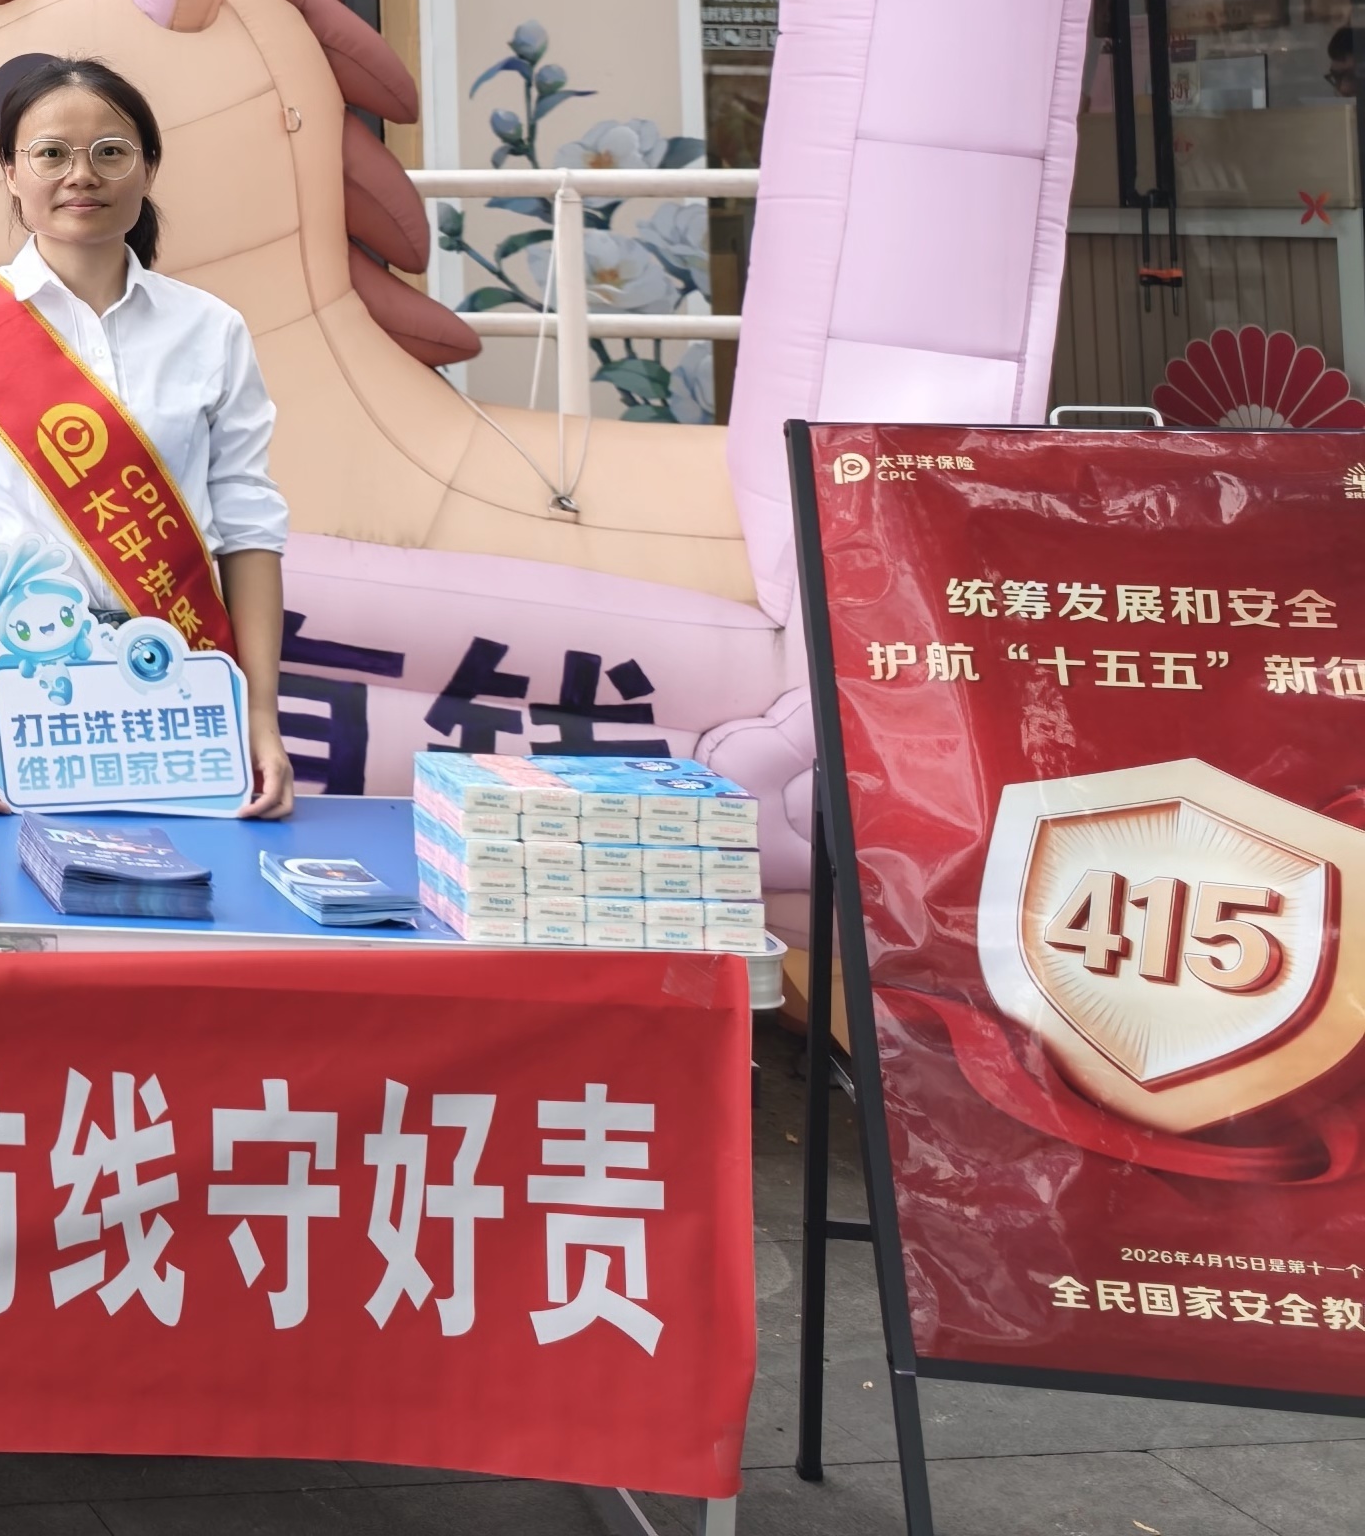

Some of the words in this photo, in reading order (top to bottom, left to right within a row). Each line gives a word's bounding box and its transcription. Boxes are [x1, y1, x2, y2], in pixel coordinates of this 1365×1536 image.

[875, 453, 977, 472] 太平洋保险
[877, 470, 917, 482] CPIC
[119, 463, 180, 541] CPIC
[946, 576, 1339, 630] 统筹发展和安全
[10, 703, 229, 748] 打击洗钱犯罪
[17, 748, 235, 794] 维护国家安全
[1043, 868, 1283, 992] 415
[1120, 1247, 1365, 1280] 2026年4月15日是第十一个
[1048, 1275, 1365, 1332] 全民国家安全教
